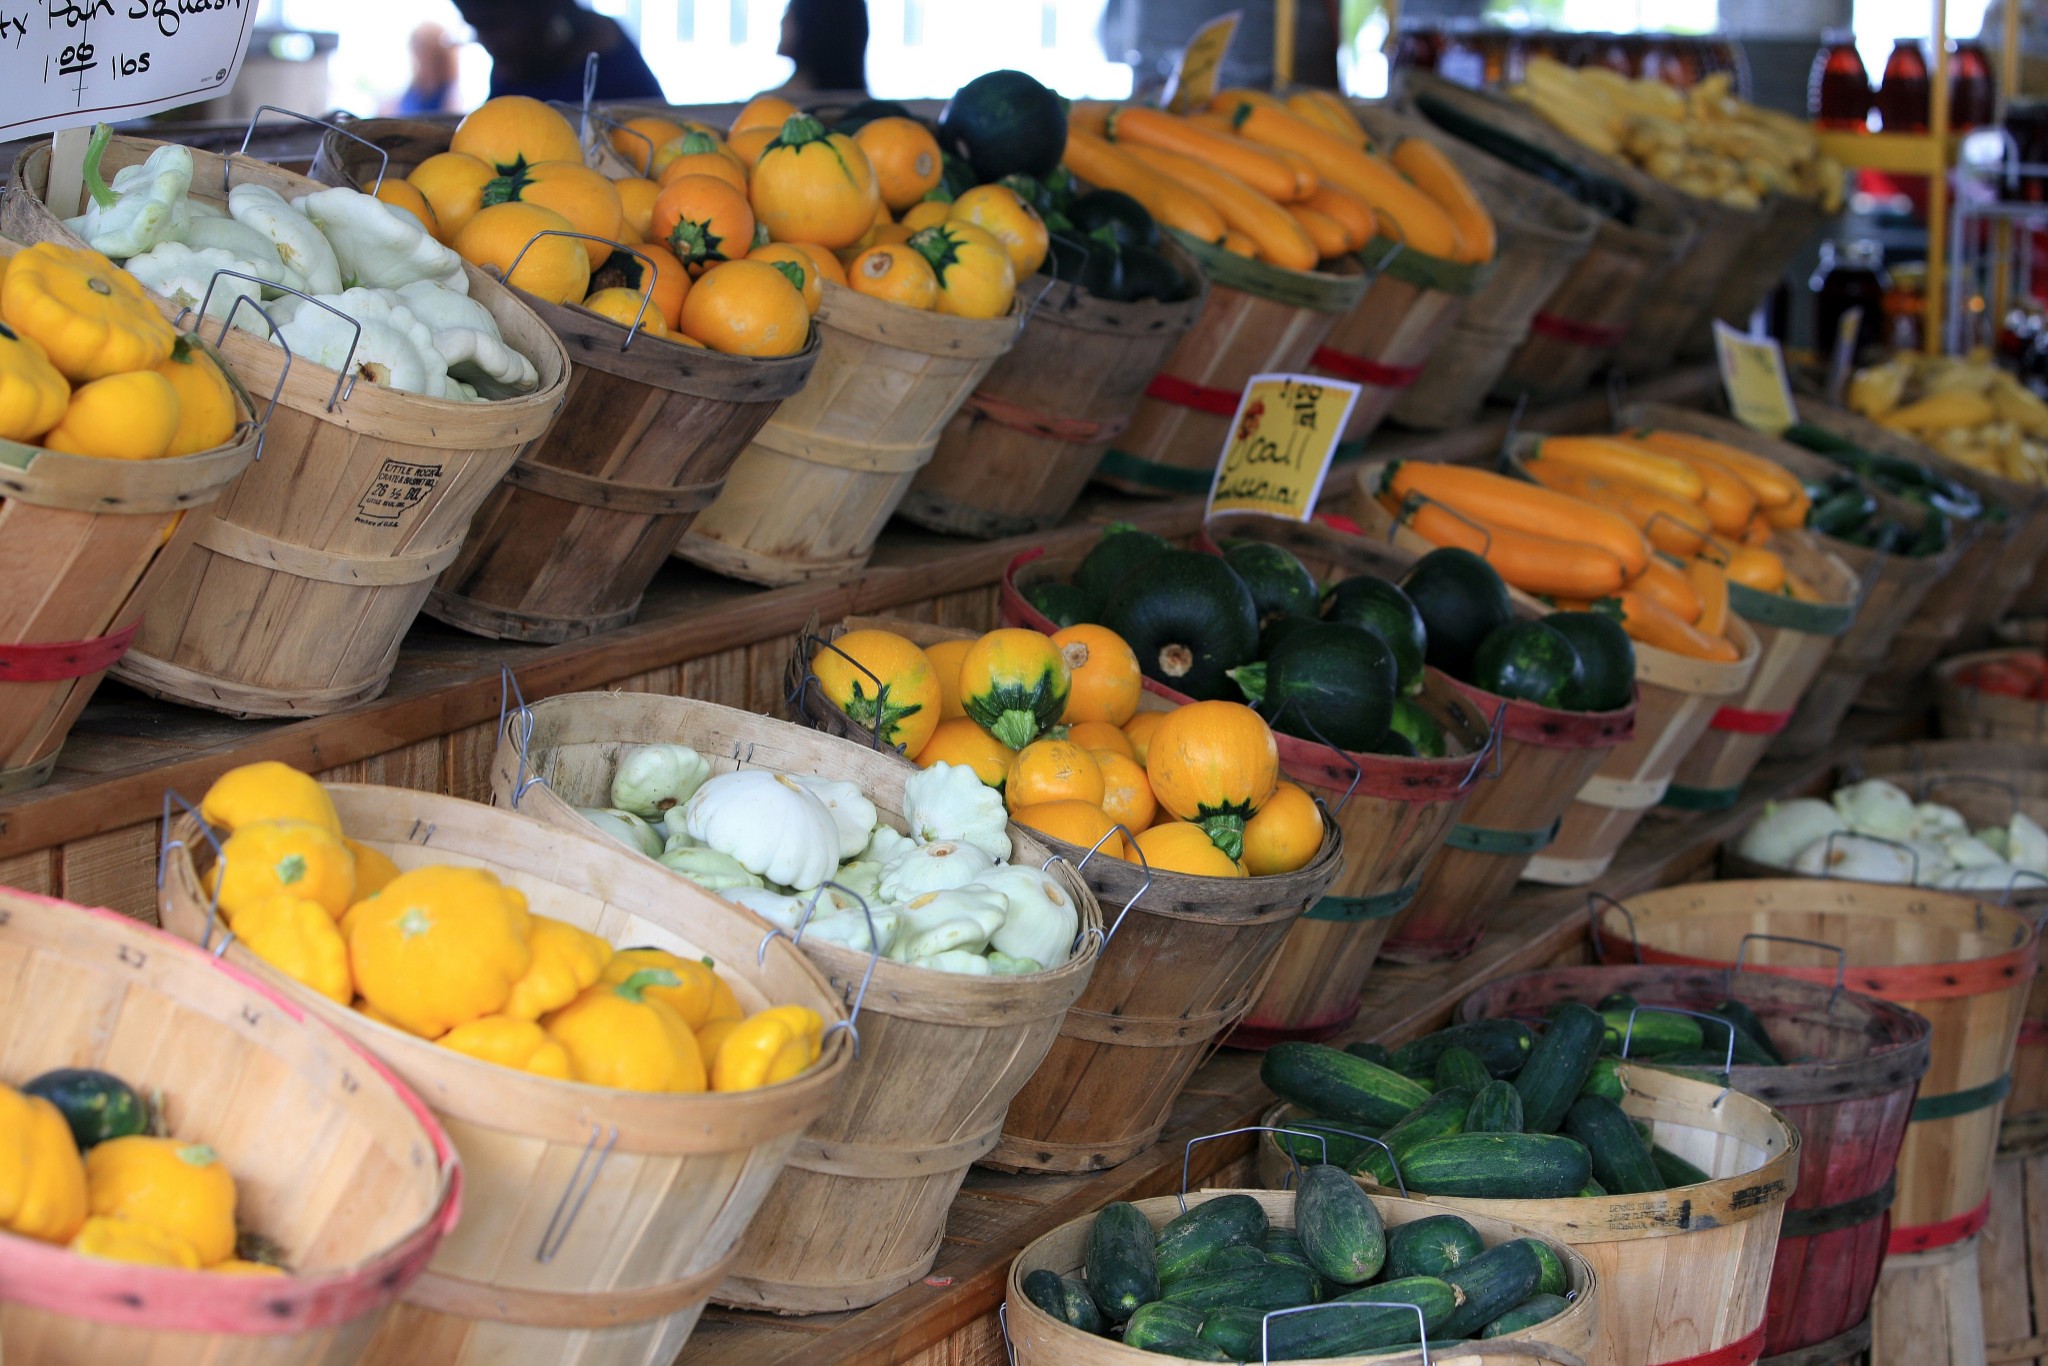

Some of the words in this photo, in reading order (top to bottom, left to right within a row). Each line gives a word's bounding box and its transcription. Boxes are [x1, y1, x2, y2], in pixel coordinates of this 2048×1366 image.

[384, 464, 413, 475] LITTLE
[414, 468, 436, 477] ROCK
[378, 472, 398, 483] CRATE
[371, 482, 389, 497] 26
[366, 497, 382, 505] LITTLE
